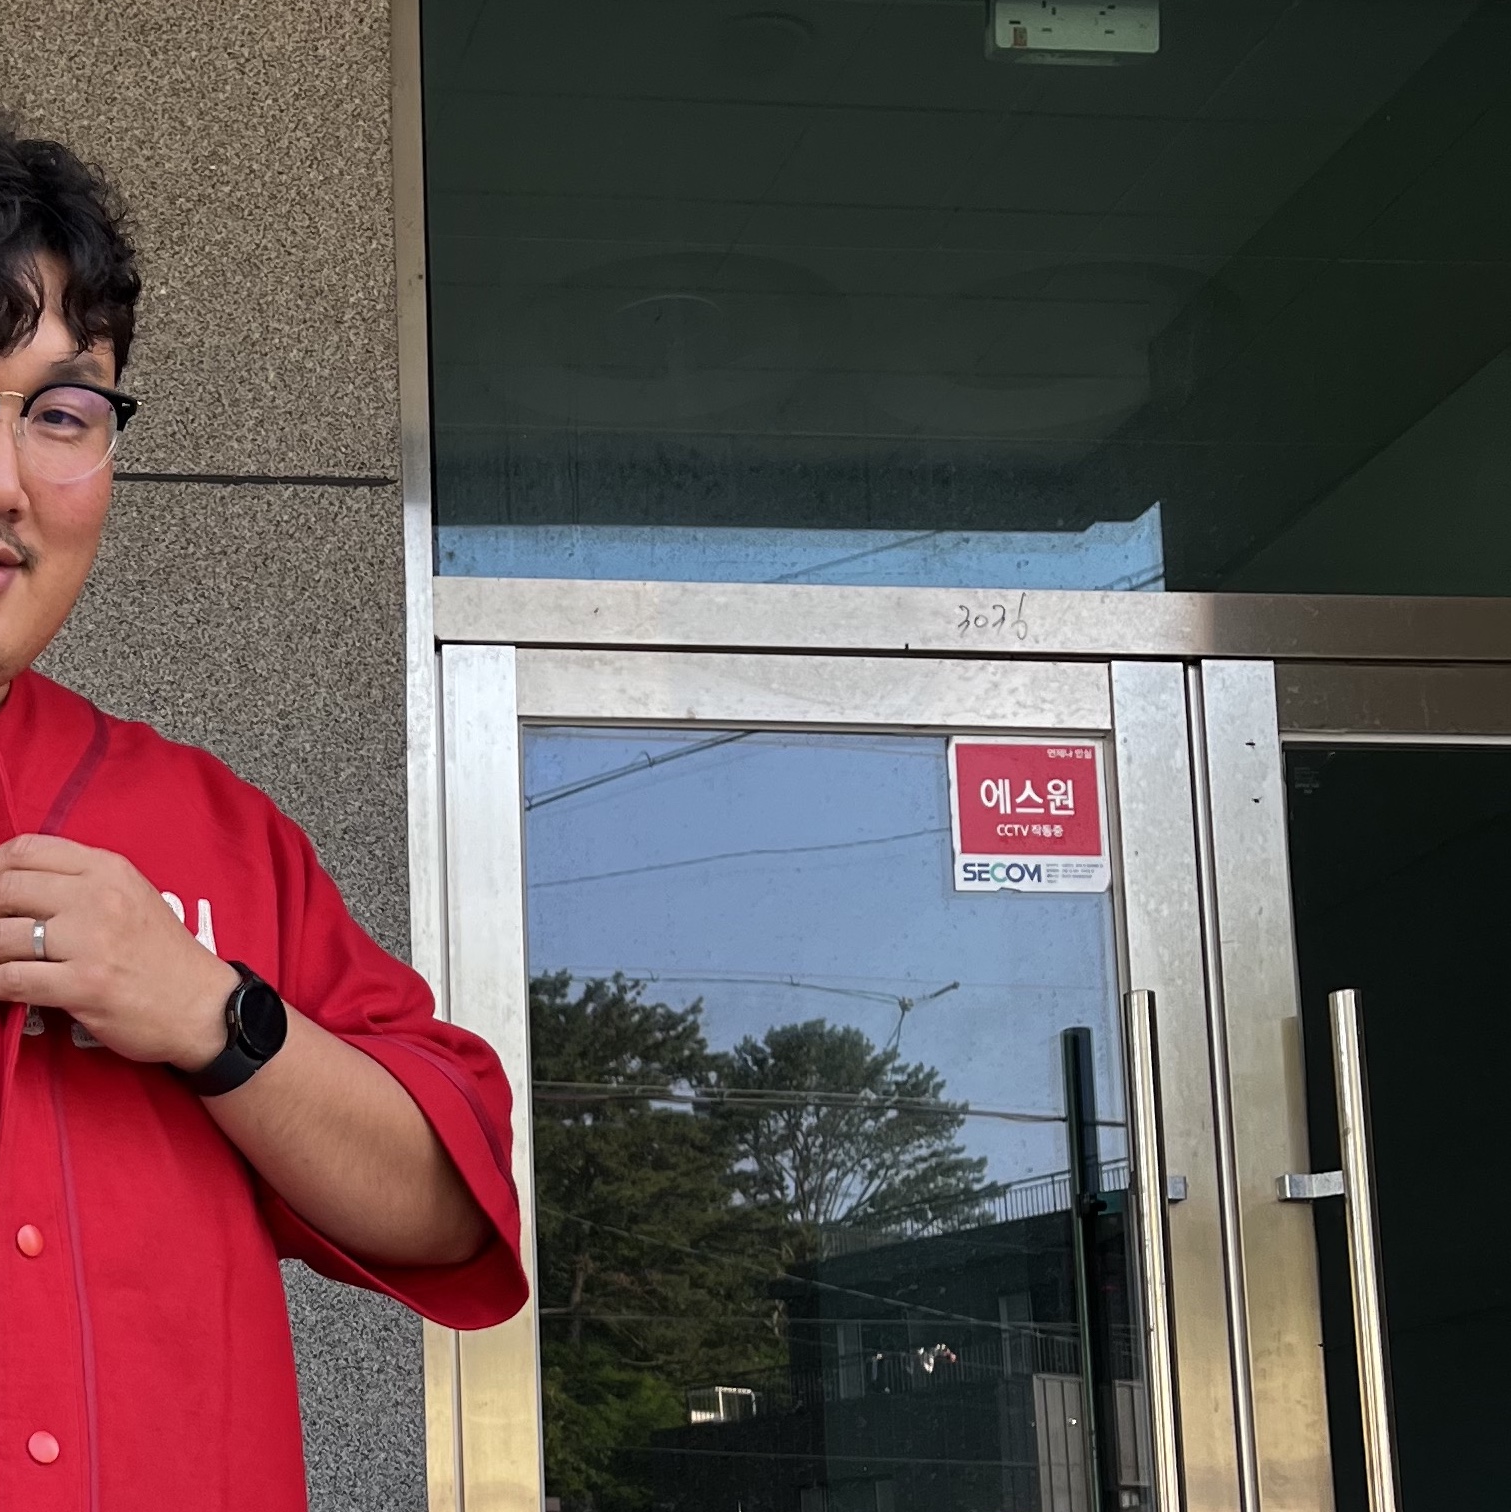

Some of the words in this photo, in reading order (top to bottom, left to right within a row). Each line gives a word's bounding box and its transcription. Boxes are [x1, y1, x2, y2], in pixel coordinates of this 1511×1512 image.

[979, 778, 1076, 816] 에스원
[996, 824, 1029, 837] CCTV
[963, 862, 1042, 883] SECOM
